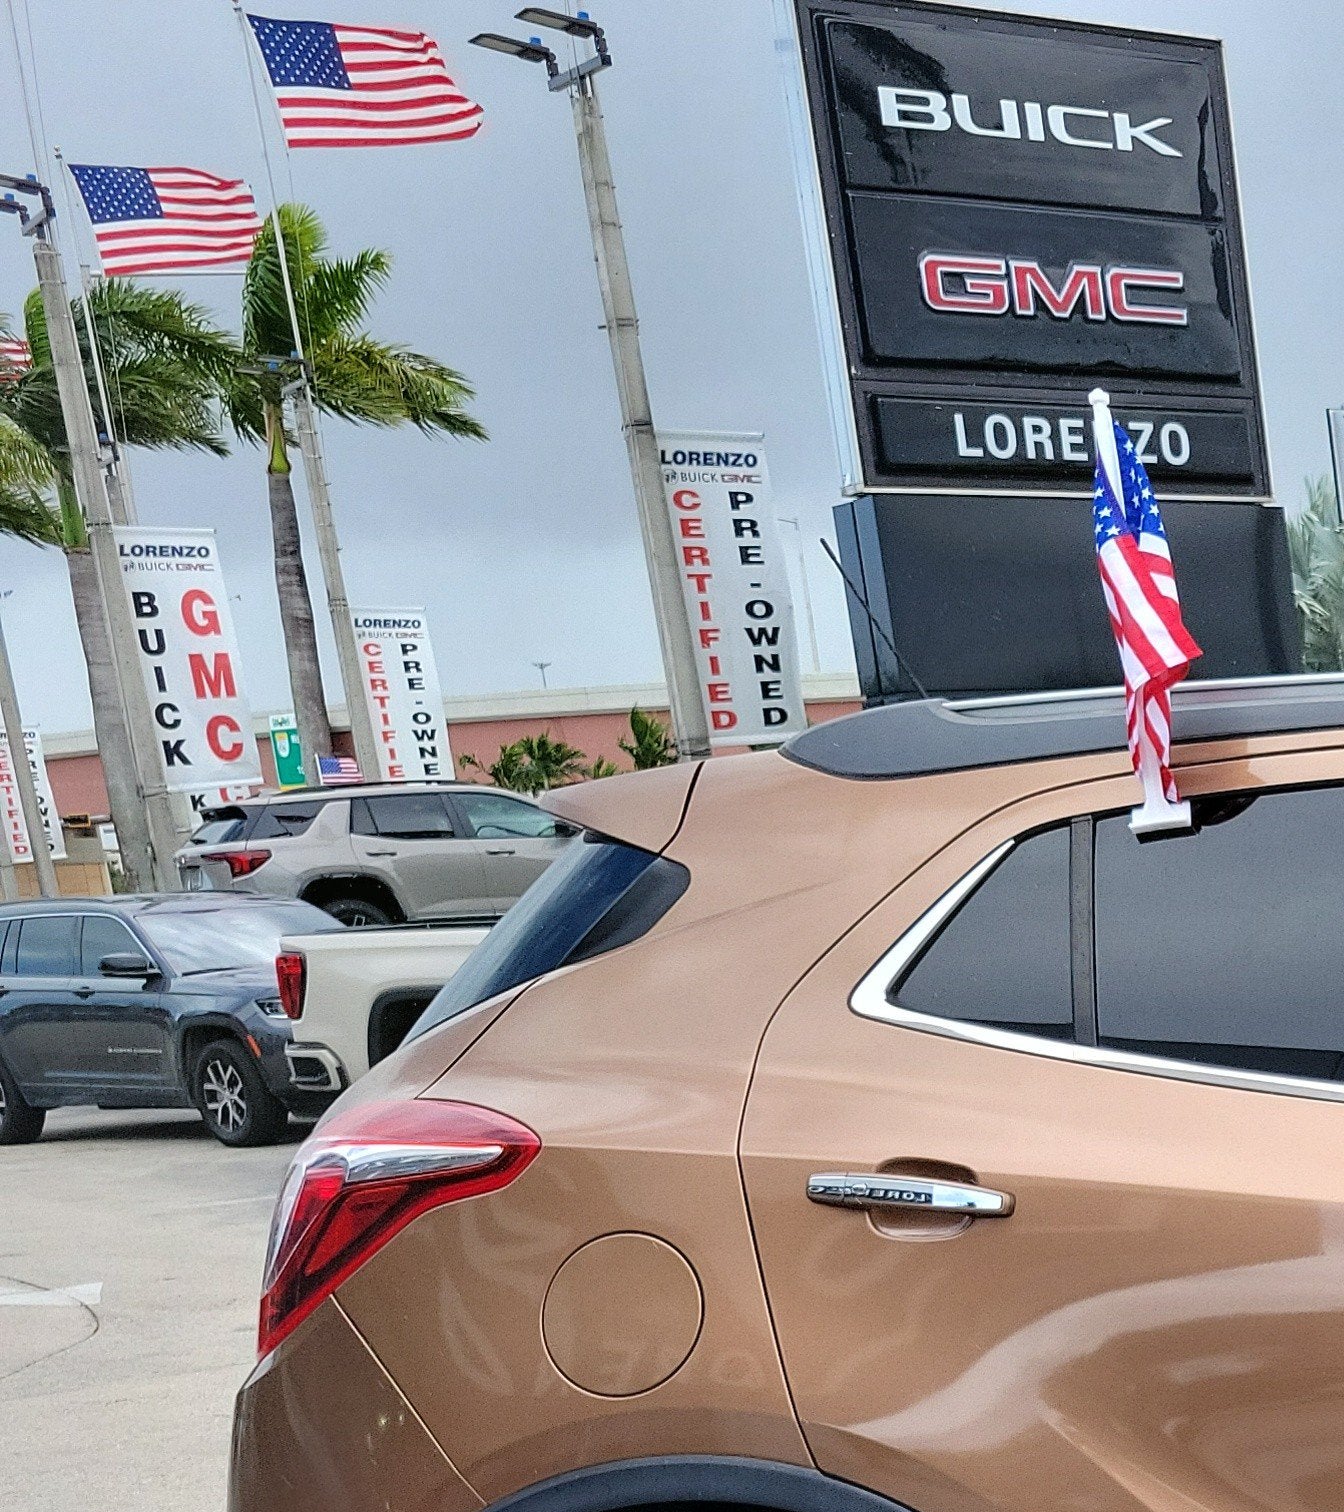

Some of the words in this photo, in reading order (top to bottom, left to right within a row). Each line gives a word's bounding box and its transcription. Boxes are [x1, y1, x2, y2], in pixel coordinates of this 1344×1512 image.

[877, 86, 1183, 158] BUICK
[919, 251, 1189, 326] GMC
[660, 449, 758, 468] LORENZO
[954, 412, 1191, 466] LOREZO
[680, 472, 718, 483] BUICK
[720, 473, 762, 484] GMC
[119, 544, 210, 558] LORENZO
[138, 562, 173, 572] BUICK
[354, 617, 421, 629] LORENZO
[672, 489, 739, 731] CERTIFIED
[728, 490, 788, 727] PRE-OWNED
[131, 591, 193, 767] BUICK
[180, 588, 244, 762] GMC
[363, 643, 405, 779] CERTIFIE
[401, 643, 442, 781] PRE-OWNE
